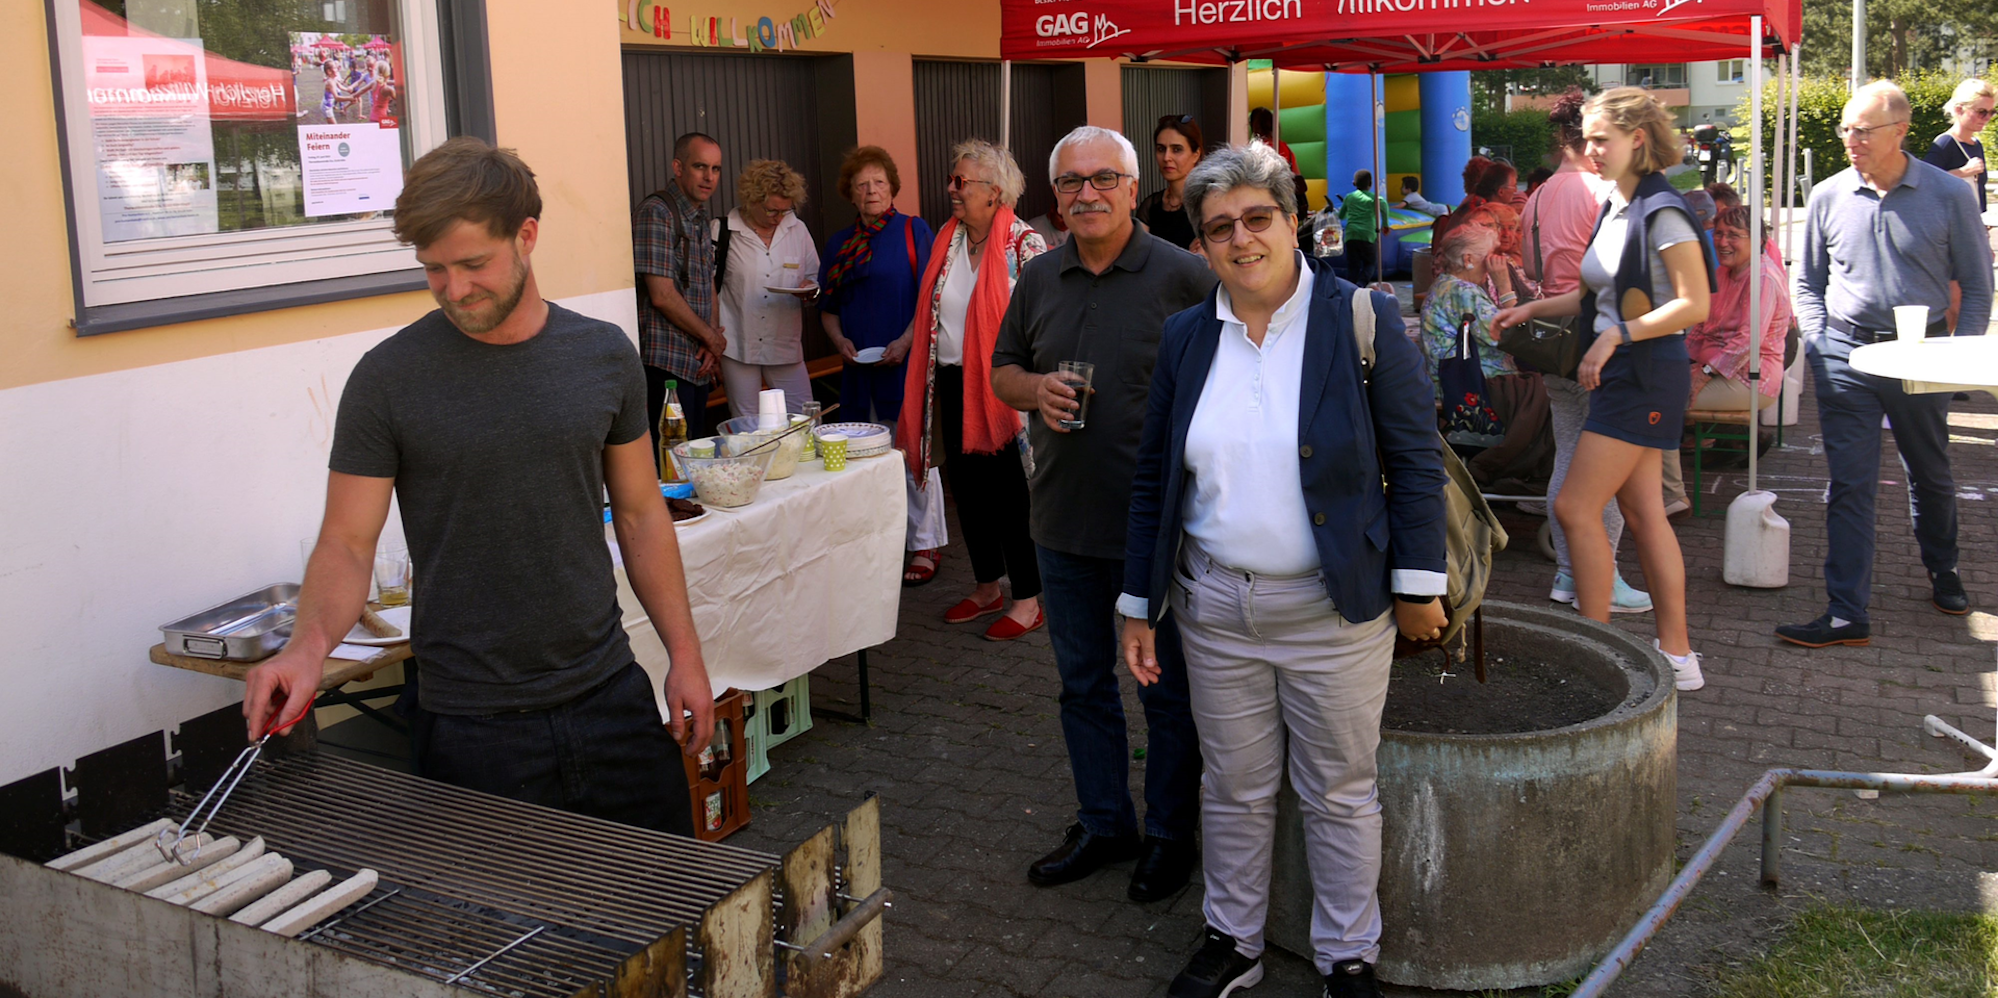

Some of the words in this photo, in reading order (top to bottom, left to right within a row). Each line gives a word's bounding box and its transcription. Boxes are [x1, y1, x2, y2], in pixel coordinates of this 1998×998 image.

[1586, 2, 1639, 12] Immobilien
[1642, 0, 1657, 9] AG
[1175, 0, 1302, 25] Herzlich
[619, 0, 671, 40] ICH
[690, 0, 836, 53] WILLKOMMEN
[1036, 12, 1088, 37] GAG
[1036, 38, 1075, 47] Immobilien
[1077, 36, 1090, 44] AG
[306, 132, 351, 141] Miteinander
[307, 143, 330, 151] Feiern
